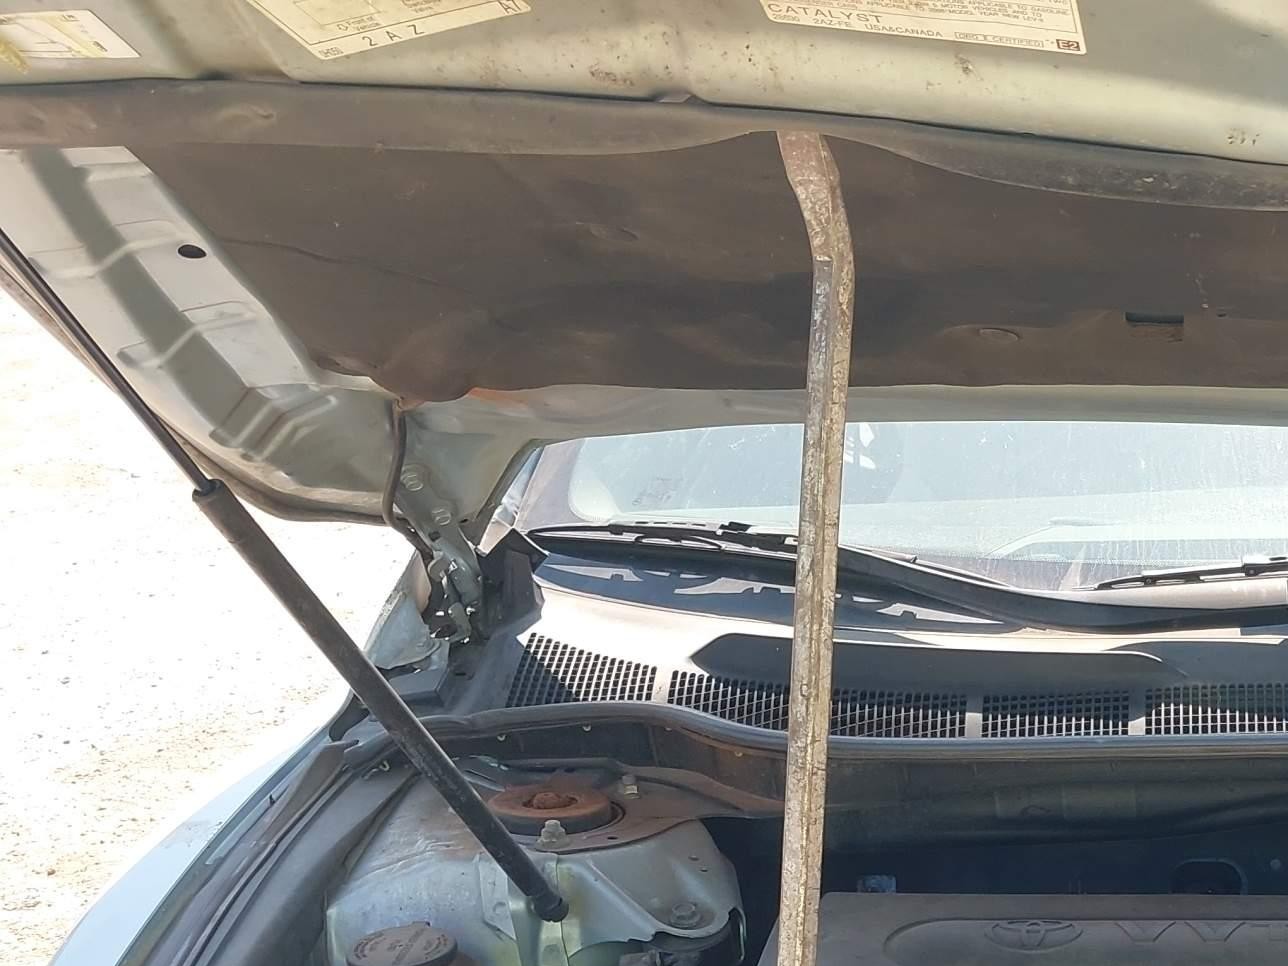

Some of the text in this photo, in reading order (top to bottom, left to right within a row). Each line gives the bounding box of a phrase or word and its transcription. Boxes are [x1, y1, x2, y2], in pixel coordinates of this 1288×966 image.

[767, 3, 883, 24] CATALYST
[361, 35, 378, 47] 2
[384, 30, 402, 42] A
[407, 23, 425, 35] Z
[864, 23, 943, 38] USA&CANADA
